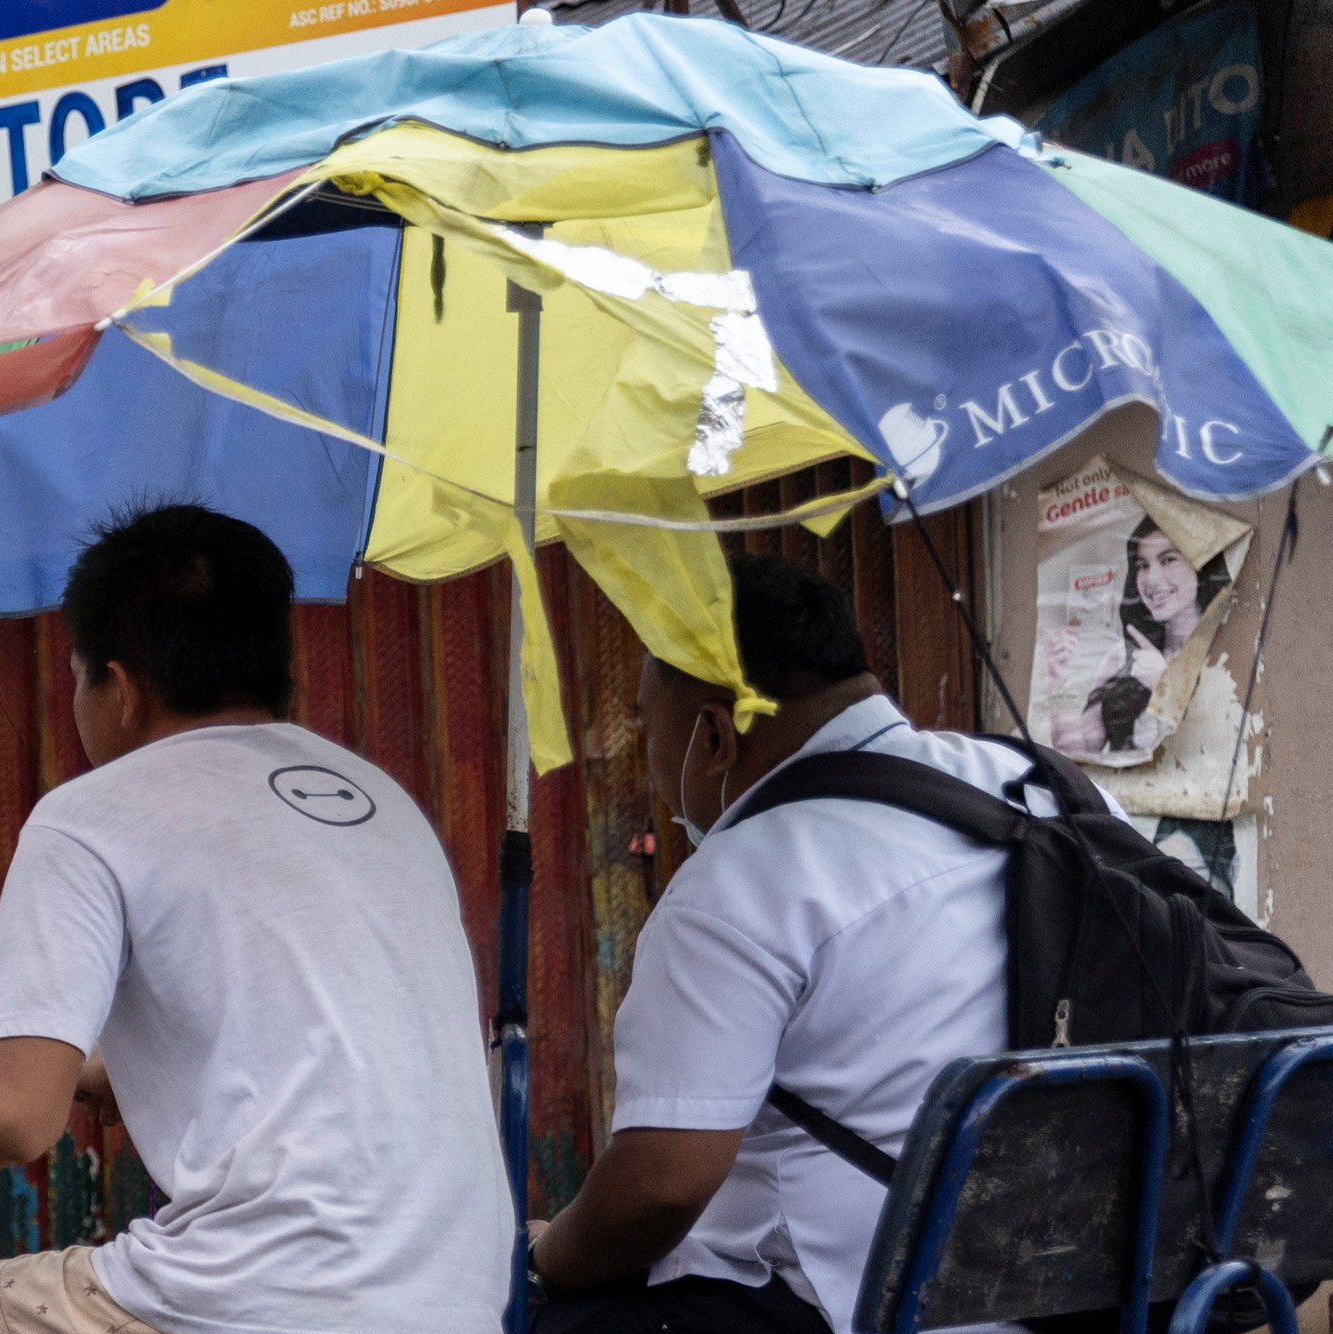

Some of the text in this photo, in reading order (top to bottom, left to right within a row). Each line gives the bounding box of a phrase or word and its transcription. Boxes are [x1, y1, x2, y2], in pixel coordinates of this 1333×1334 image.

[289, 11, 317, 29] ASC
[319, 5, 344, 23] REF
[10, 36, 81, 72] SELECT
[84, 23, 151, 57] AREAS
[1054, 467, 1114, 496] Not only
[1045, 485, 1110, 523] Gentle
